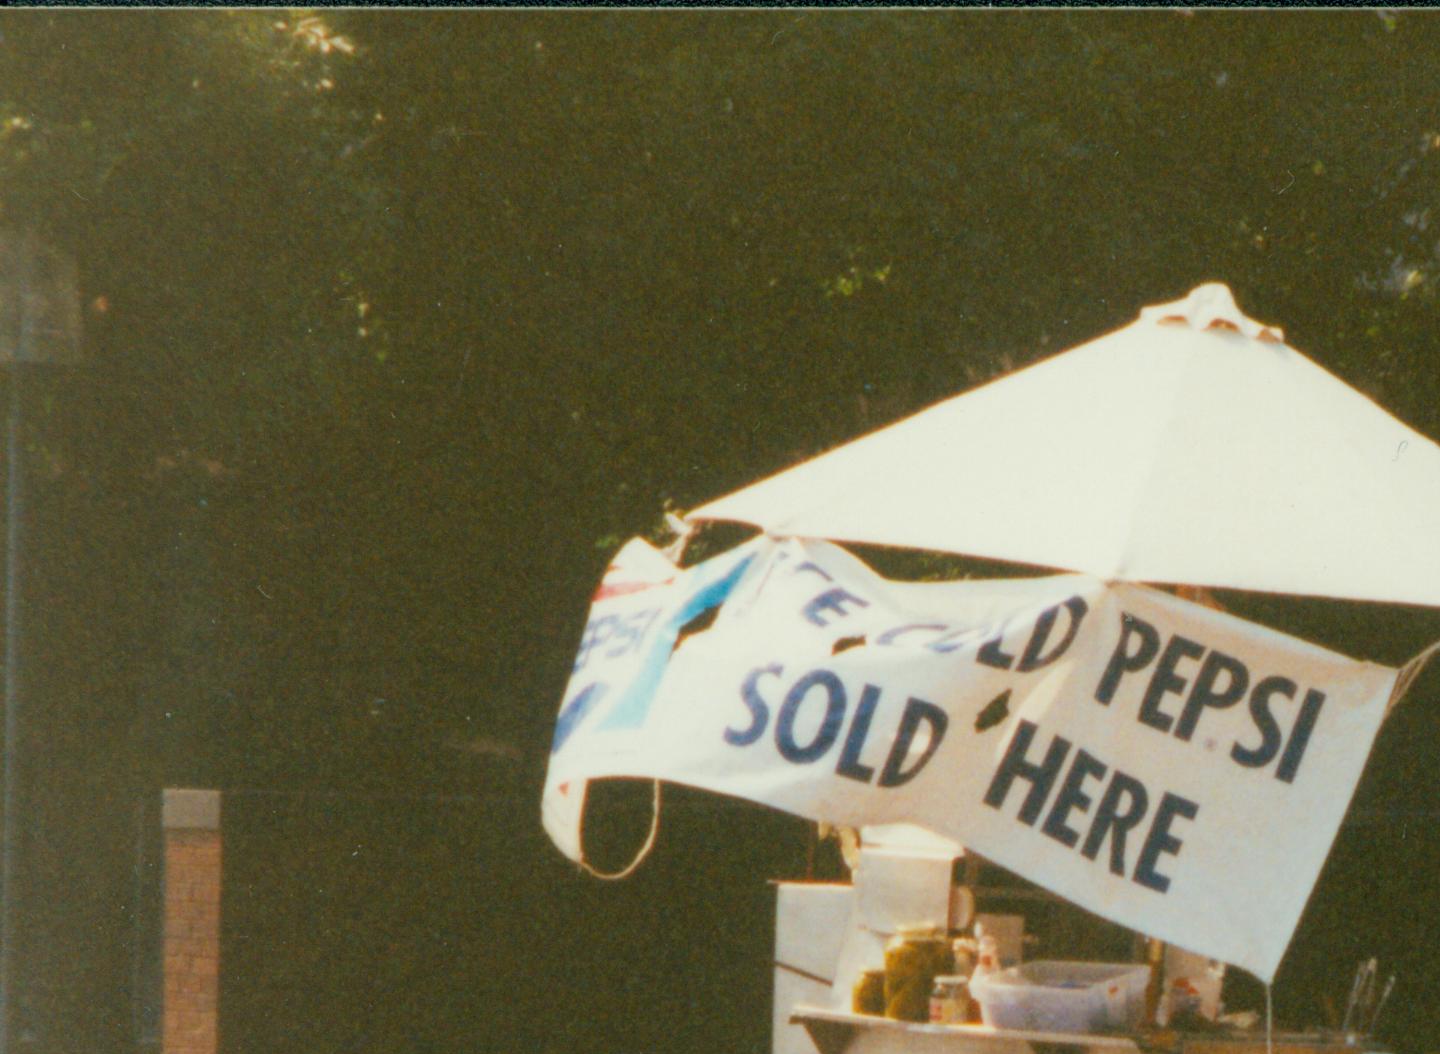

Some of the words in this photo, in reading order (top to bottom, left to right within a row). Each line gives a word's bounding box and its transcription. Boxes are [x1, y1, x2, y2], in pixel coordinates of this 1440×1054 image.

[723, 662, 949, 788] SOLD
[976, 718, 1200, 894] HERE
[1094, 611, 1327, 785] PEPSI
